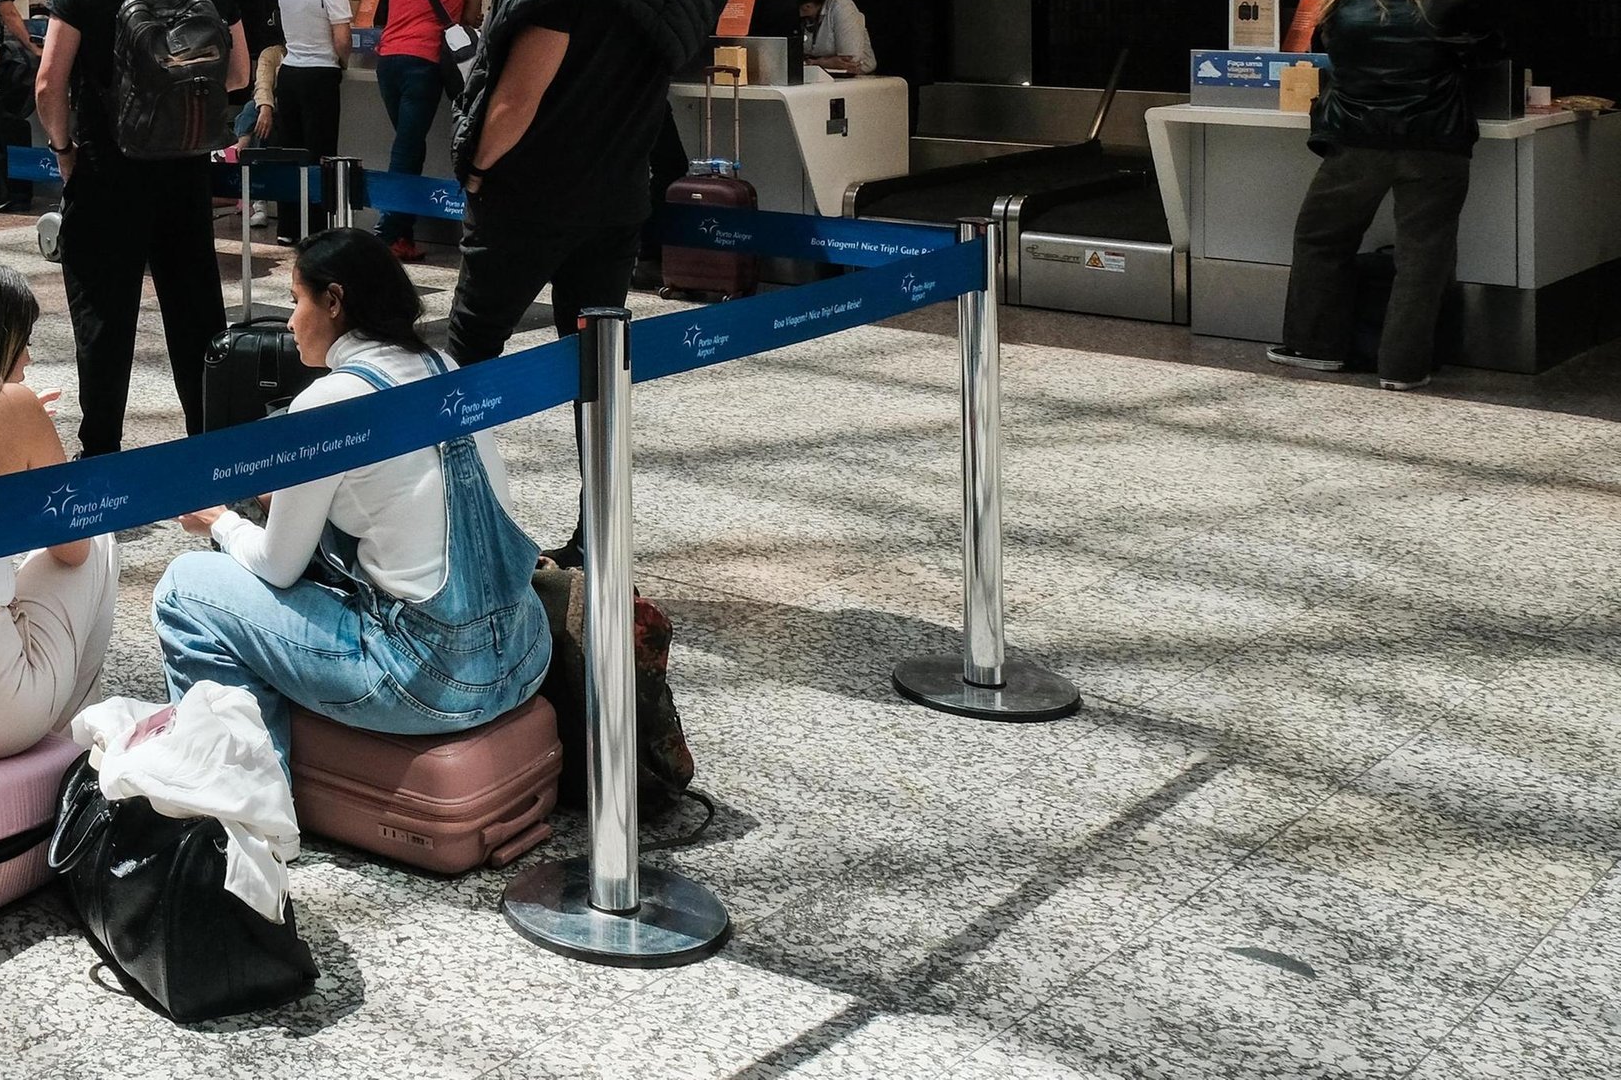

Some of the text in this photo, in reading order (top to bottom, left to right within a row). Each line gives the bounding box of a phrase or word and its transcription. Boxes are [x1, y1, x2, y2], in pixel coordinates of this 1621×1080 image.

[810, 237, 826, 246] Boa
[827, 238, 859, 252] Viagem!
[861, 242, 878, 252] Nice
[880, 242, 898, 256] Trip!
[900, 246, 920, 256] Gute
[774, 298, 862, 330] Boa Viagem! Nice Trip! Gute Reise!
[698, 333, 729, 348] Porto Alegre
[697, 346, 716, 358] Airport
[461, 394, 502, 415] Porto Alegre
[460, 411, 484, 427] Airport
[212, 429, 371, 480] Boa Viagem! Nice Trip! Gute Reise!
[72, 494, 130, 516] Porto Alegre
[69, 512, 104, 530] Airport
